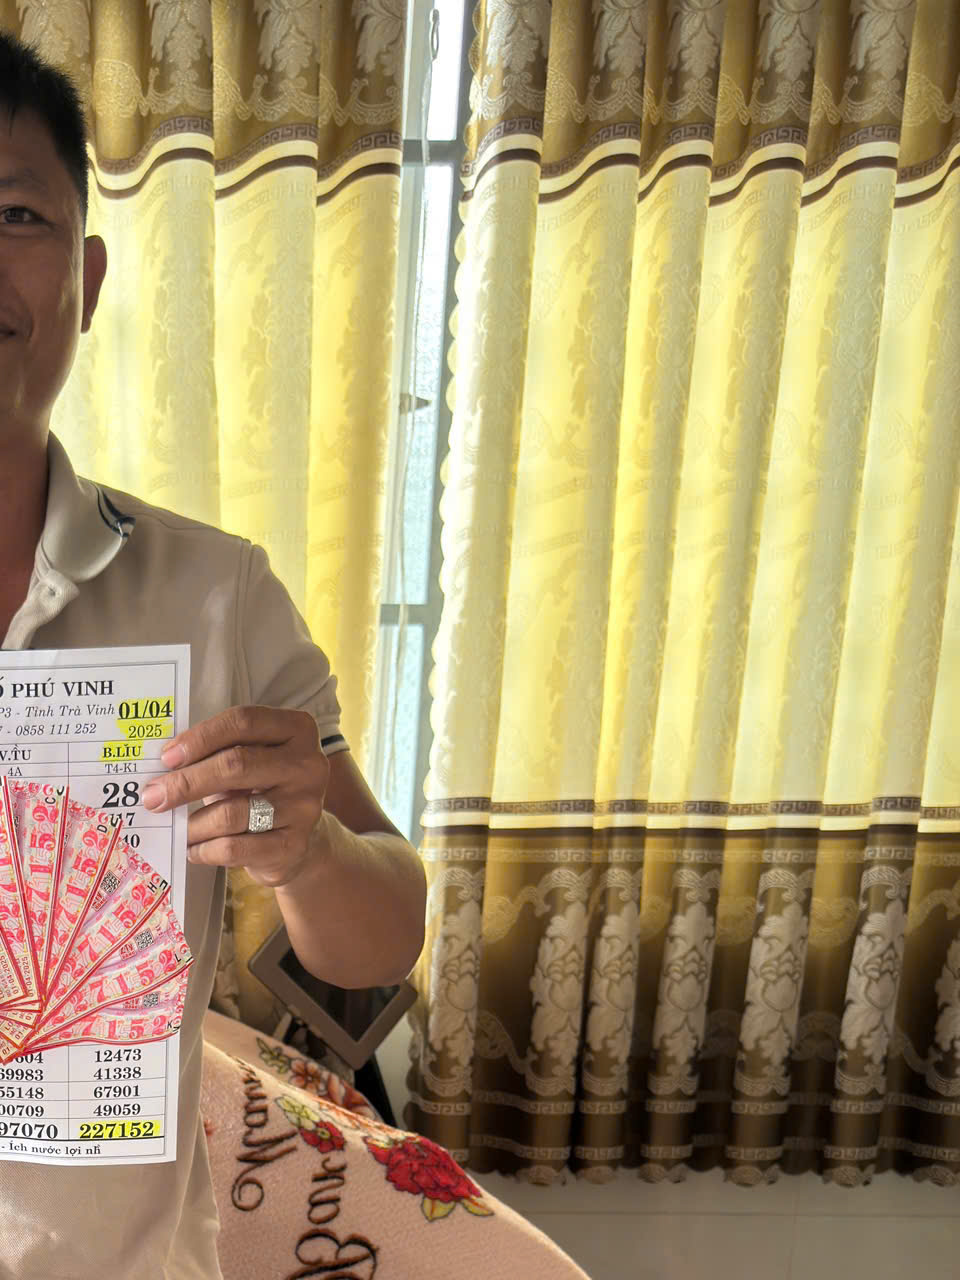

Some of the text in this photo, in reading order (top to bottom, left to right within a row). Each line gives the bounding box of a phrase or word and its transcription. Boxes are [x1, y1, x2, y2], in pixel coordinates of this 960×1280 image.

[11, 678, 54, 698] PHÚ
[62, 680, 114, 697] VINH
[59, 706, 81, 717] Trà
[86, 704, 115, 716] Vinh
[118, 700, 172, 720] 01/04
[16, 725, 44, 736] 0858
[50, 724, 70, 735] 111
[74, 723, 97, 734] 252
[128, 725, 162, 739] 2025
[7, 767, 23, 777] 4A
[105, 763, 137, 774] T4-K1
[44, 796, 55, 804] C
[102, 782, 139, 808] 28
[96, 823, 108, 833] D
[146, 881, 158, 893] H
[166, 1020, 173, 1028] K
[95, 1049, 142, 1063] 12473
[94, 1067, 141, 1080] 41338
[94, 1085, 140, 1098] 67901
[93, 1104, 141, 1116] 49059
[79, 1122, 154, 1139] 227152
[9, 1140, 27, 1152] Ích
[31, 1145, 61, 1154] nước
[65, 1146, 81, 1157] lợi
